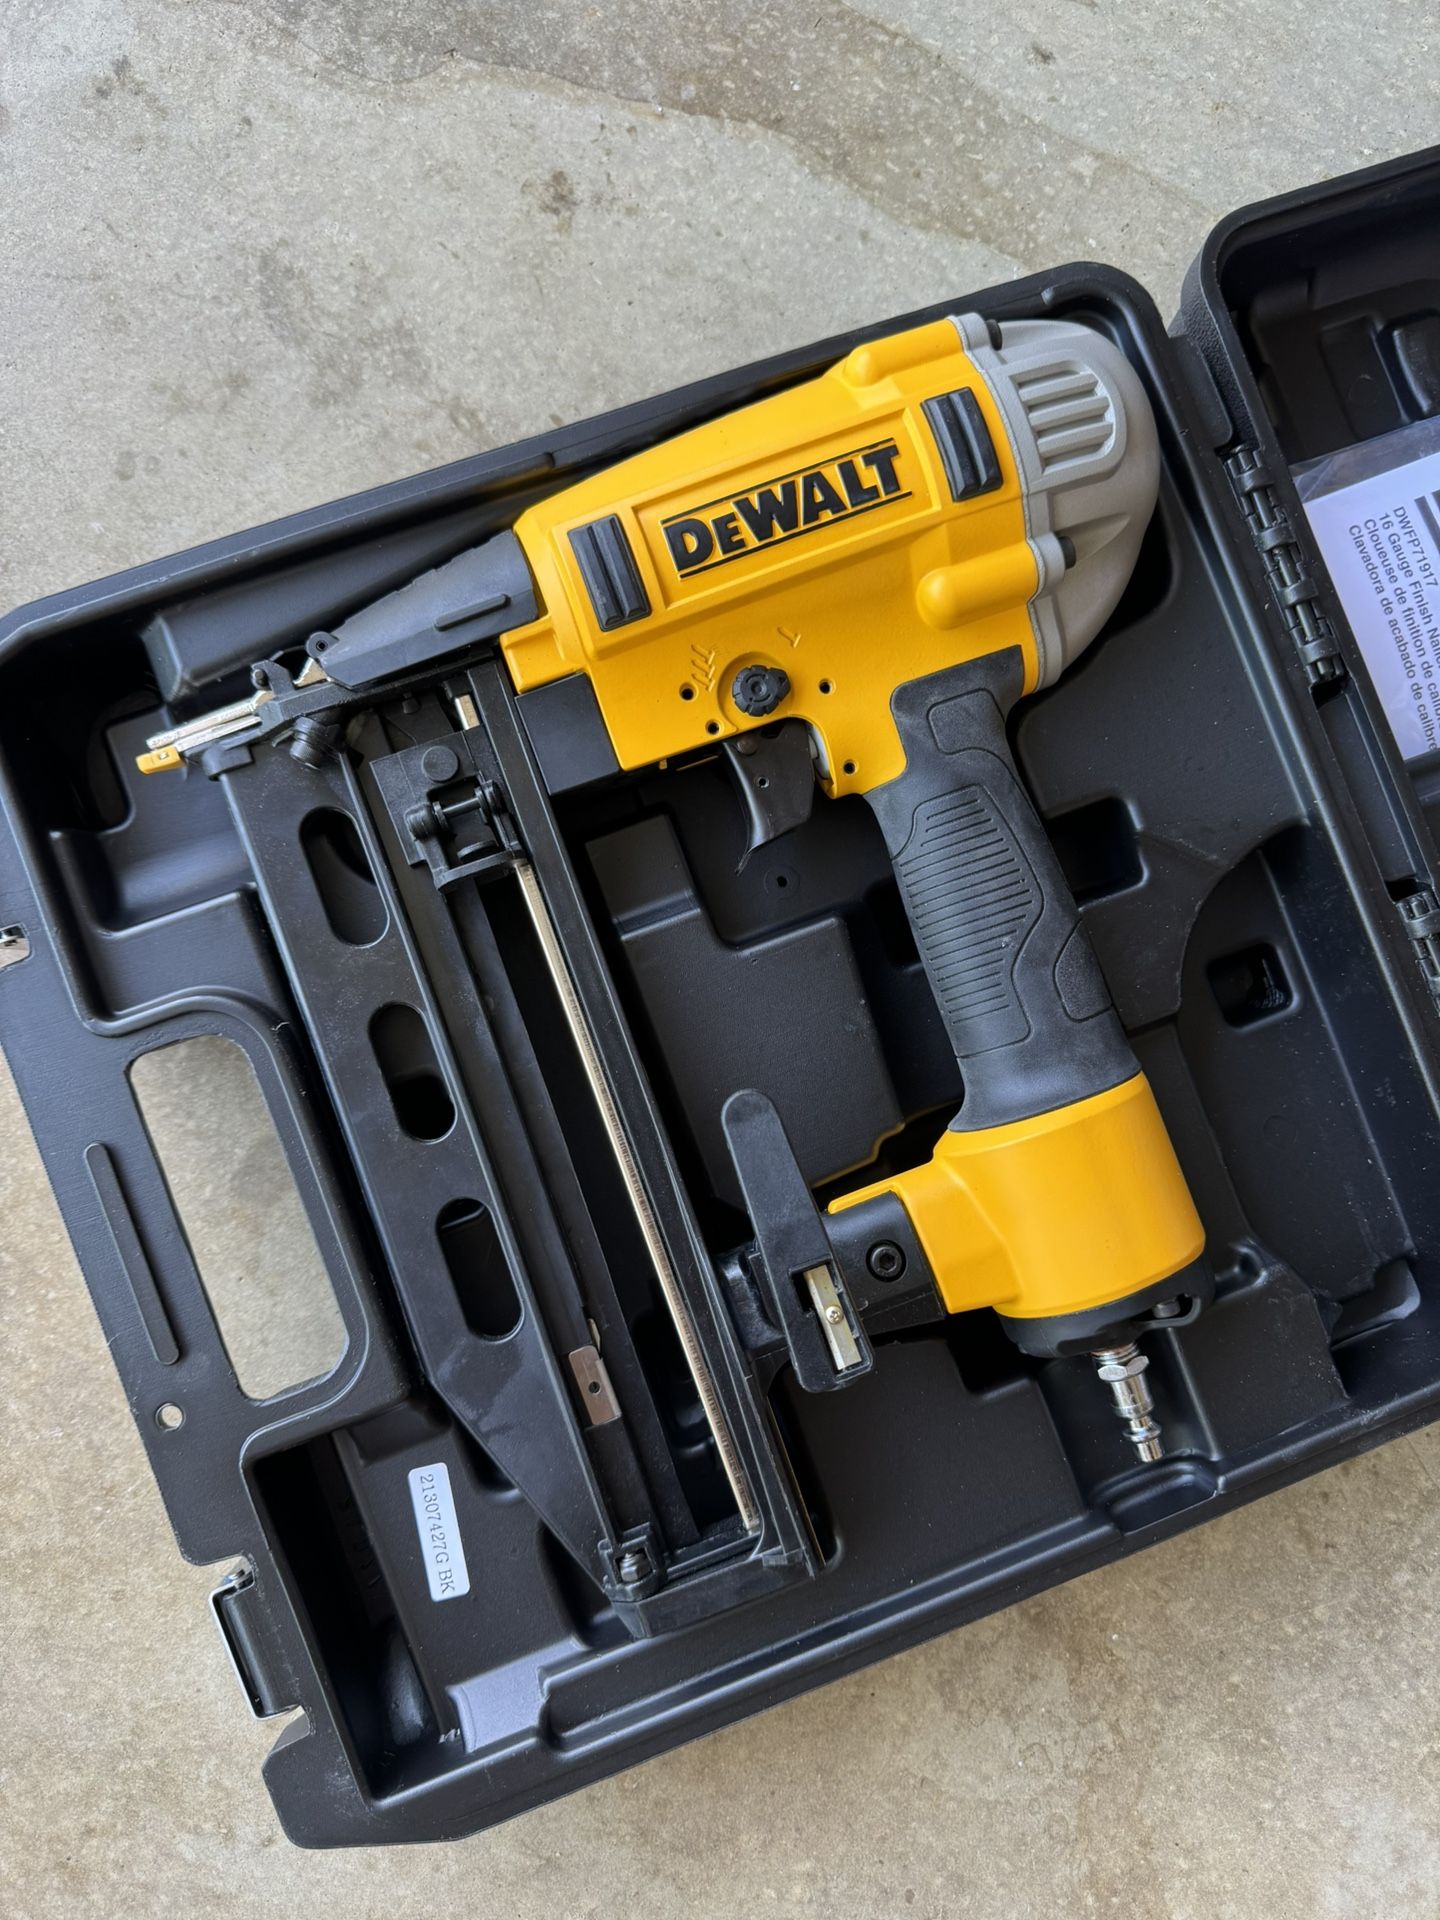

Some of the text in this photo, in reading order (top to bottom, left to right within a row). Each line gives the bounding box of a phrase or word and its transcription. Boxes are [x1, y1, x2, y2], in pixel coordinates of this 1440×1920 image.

[1364, 519, 1398, 584] Cloueuse
[1394, 587, 1407, 605] de
[1402, 607, 1426, 657] finition
[1421, 661, 1433, 679] de
[1379, 512, 1394, 530] 16
[1388, 533, 1414, 578] Gauge
[1408, 580, 1433, 625] Finish
[1393, 506, 1439, 587] DWFP71917
[1349, 525, 1385, 594] Clavadora
[1380, 597, 1393, 615] de
[1388, 619, 1416, 678] acabado
[1410, 682, 1423, 700] de
[420, 1473, 455, 1595] 21307427G BK
